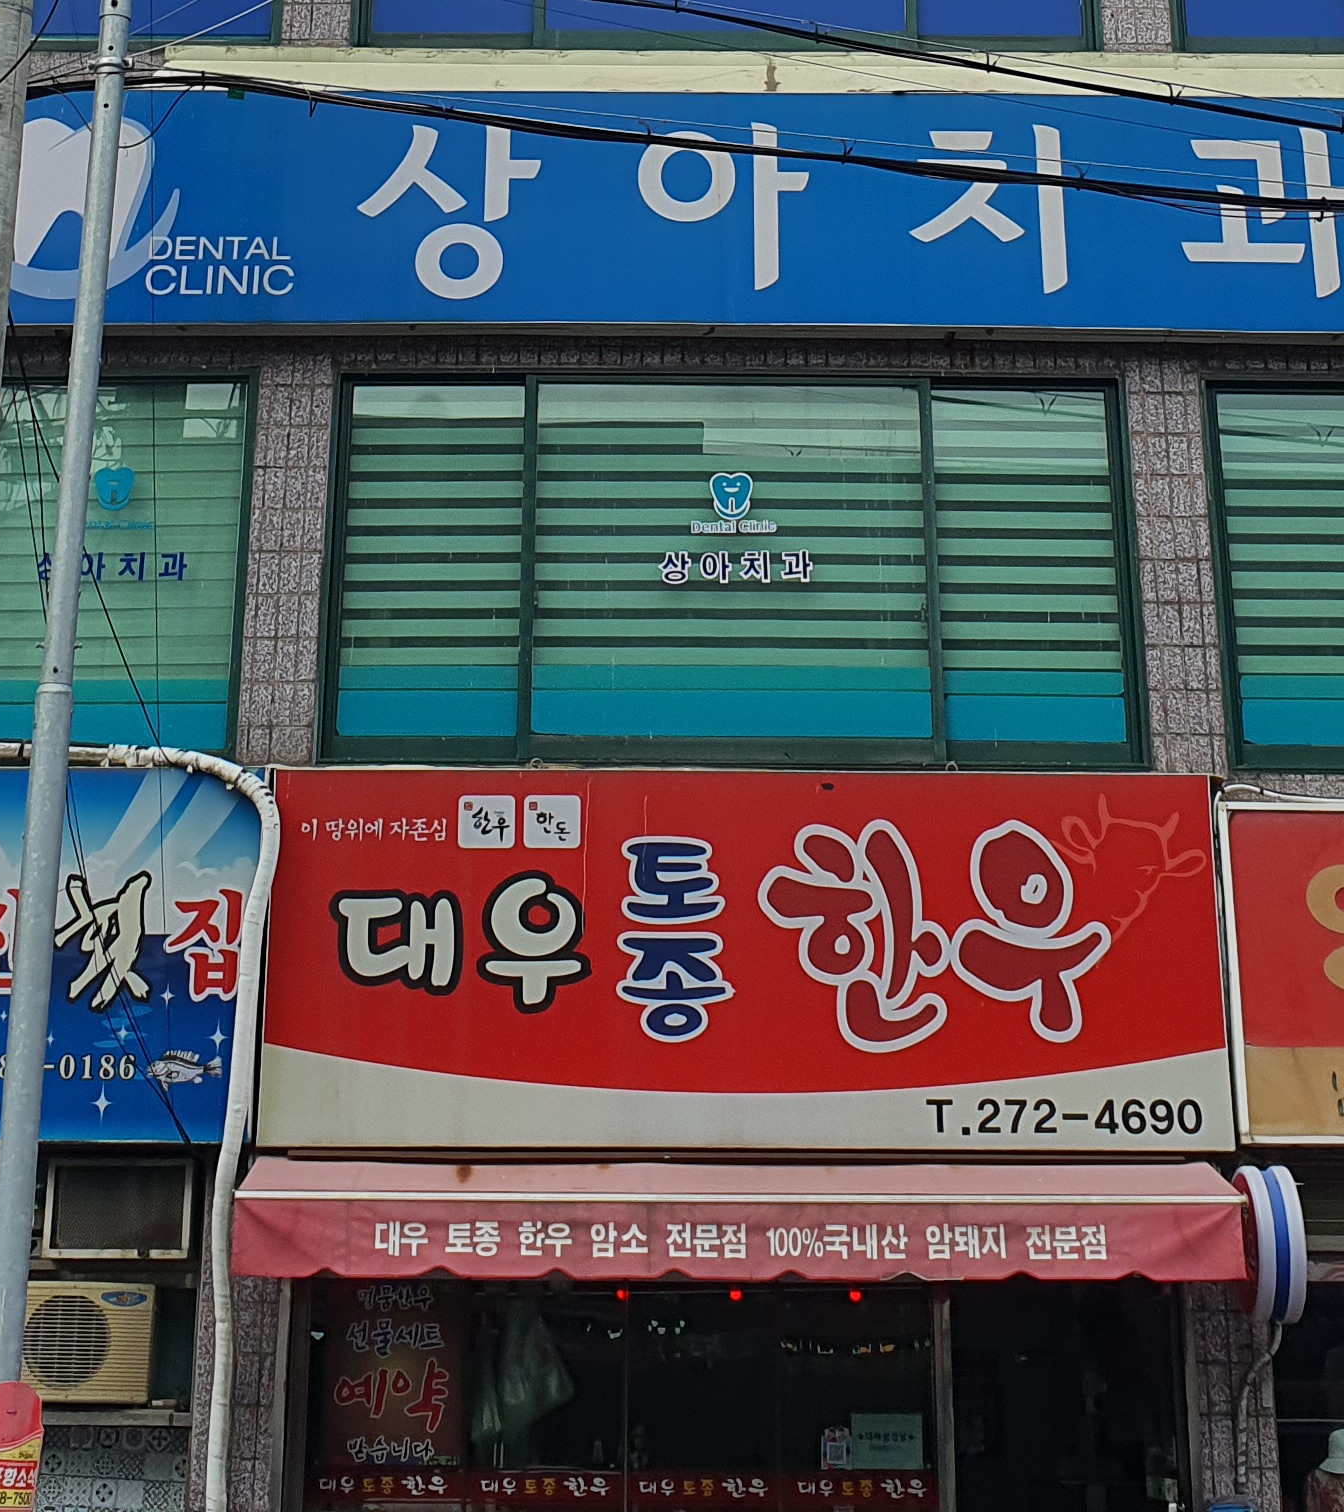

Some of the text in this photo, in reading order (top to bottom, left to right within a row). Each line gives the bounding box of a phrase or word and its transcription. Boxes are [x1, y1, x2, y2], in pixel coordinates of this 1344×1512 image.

[148, 236, 292, 261] DENTAL
[145, 264, 295, 296] CLINIC
[690, 519, 777, 534] Dental Clinic
[658, 550, 813, 585] 상아치과
[300, 816, 448, 842] 이 땅위에 자존심
[329, 818, 1113, 1054] 대우 토종 한우
[926, 1097, 1204, 1137] T.272-4690
[374, 1221, 428, 1257] 대우
[445, 1221, 501, 1257] 토종
[518, 1221, 573, 1257] 한우
[590, 1221, 649, 1258] 암소
[666, 1222, 748, 1259] 전문점
[766, 1223, 909, 1260] 100%국내산
[1025, 1224, 1108, 1260] 전문점
[346, 1318, 445, 1358] 선물세트
[334, 1357, 450, 1434] 예약
[347, 1435, 435, 1465] 받습니다
[319, 1475, 355, 1494] 대우
[401, 1474, 449, 1496] 한우
[481, 1477, 517, 1495] 대우
[563, 1476, 611, 1497] 한우
[639, 1478, 675, 1496] 대우
[721, 1477, 769, 1498] 한우
[797, 1479, 834, 1497] 대우
[880, 1478, 928, 1499] 한우
